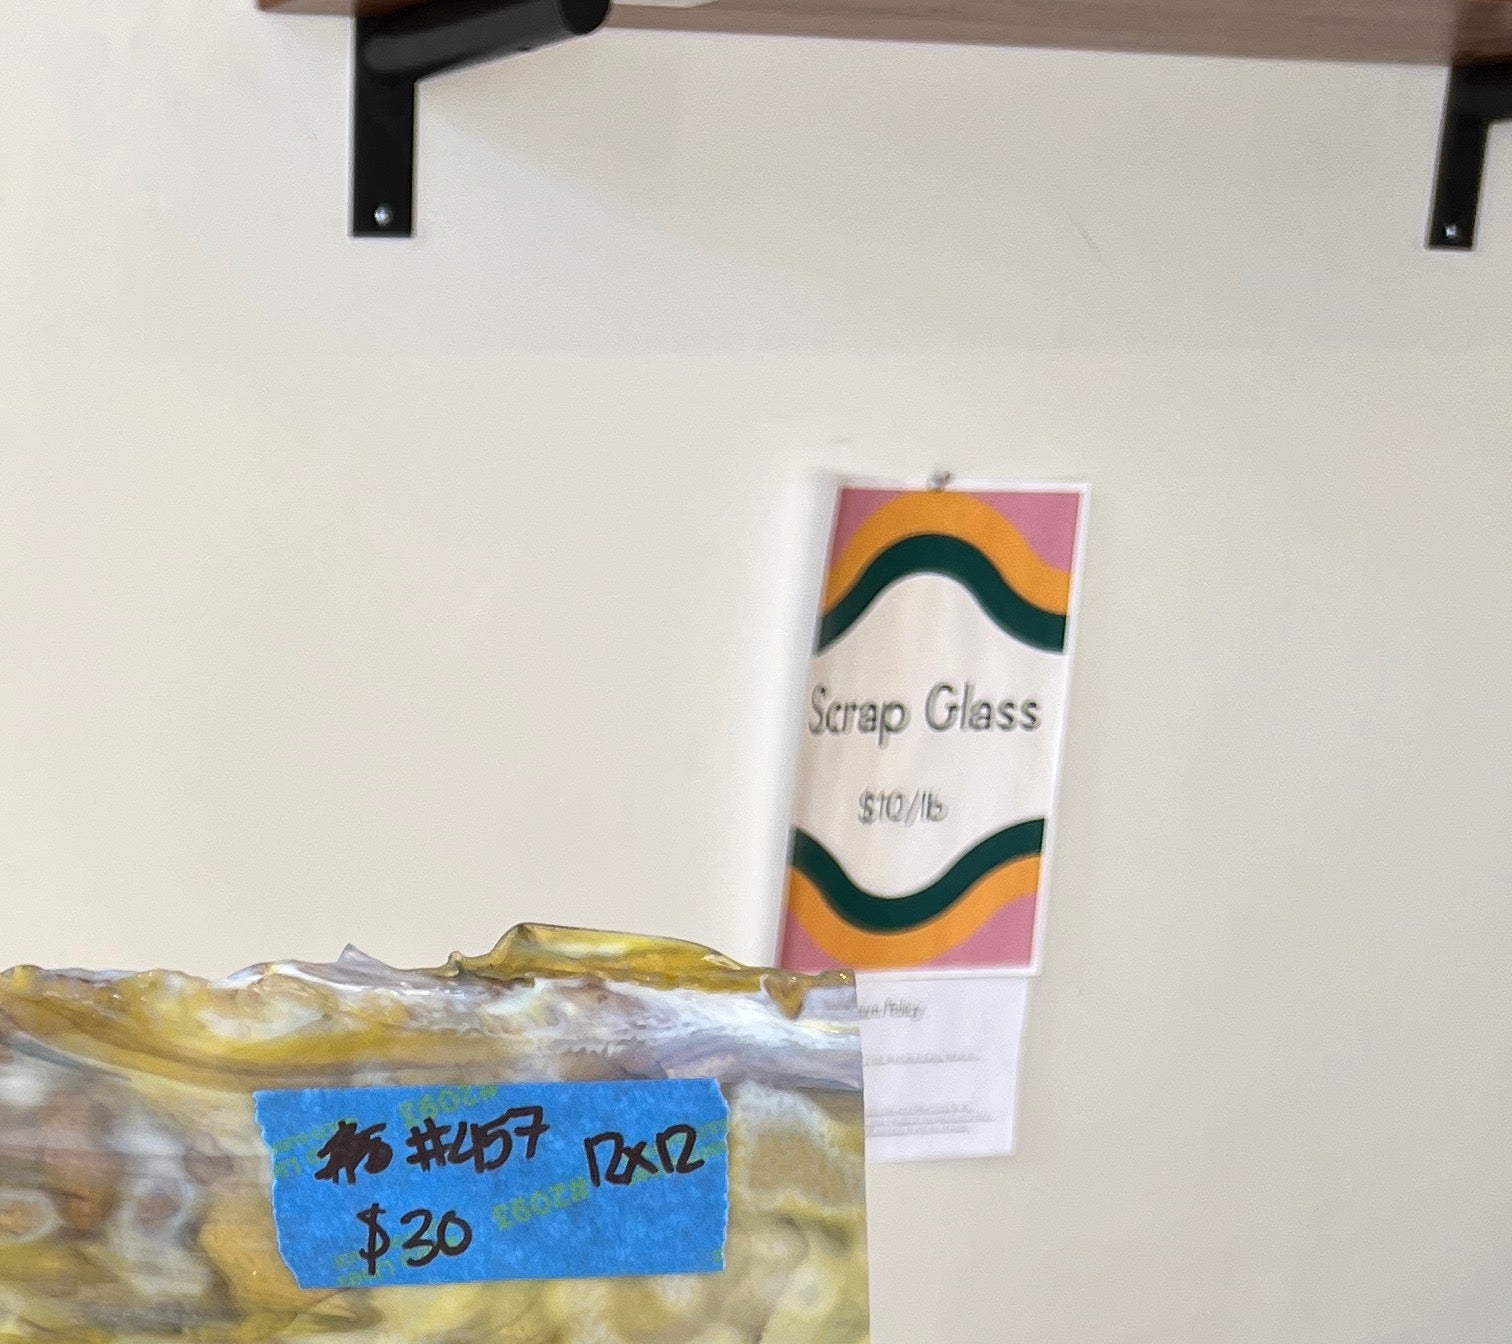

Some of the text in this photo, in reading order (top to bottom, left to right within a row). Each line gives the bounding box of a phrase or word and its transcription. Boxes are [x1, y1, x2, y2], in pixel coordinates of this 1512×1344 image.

[808, 680, 1042, 749] Scrap Glass
[858, 787, 950, 827] $10/lb
[405, 1105, 551, 1174] #457
